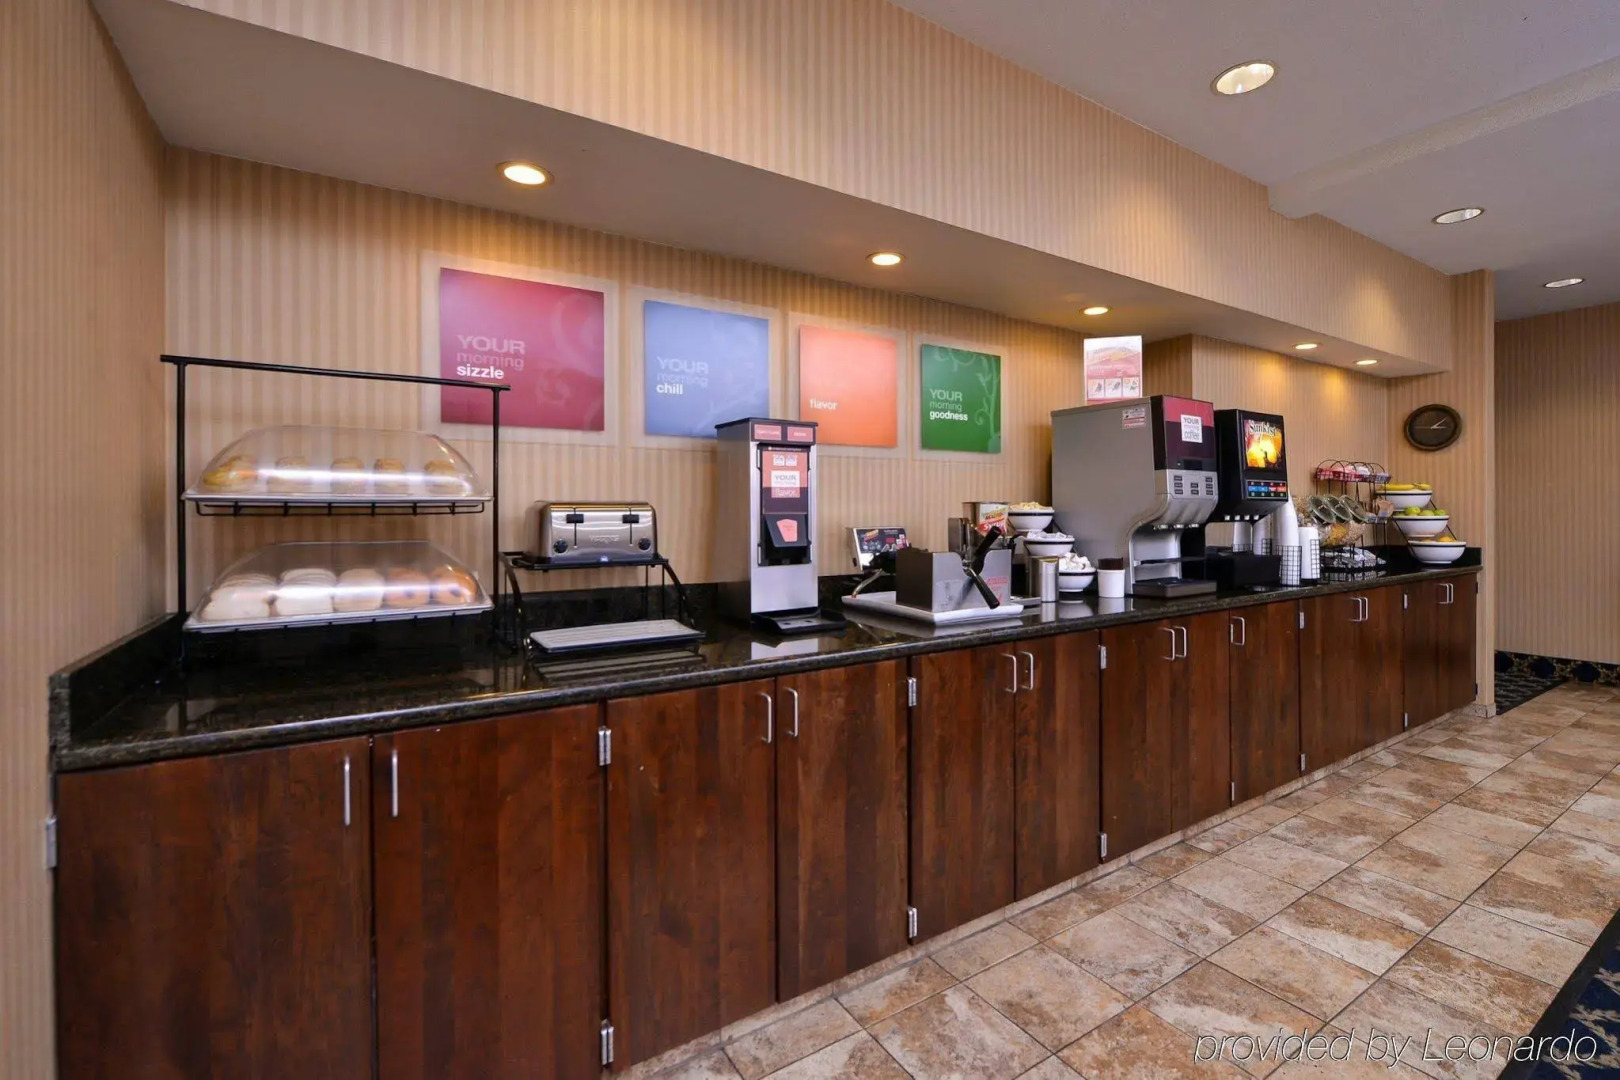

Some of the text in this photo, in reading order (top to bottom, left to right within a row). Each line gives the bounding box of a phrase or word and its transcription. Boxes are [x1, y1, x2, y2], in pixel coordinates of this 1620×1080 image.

[457, 334, 525, 355] YOUR
[457, 352, 524, 372] morning
[656, 355, 709, 374] YOUR
[456, 363, 504, 380] sizzle
[656, 382, 684, 395] chill
[929, 388, 963, 402] YOUR
[810, 397, 838, 411] flavor
[929, 401, 963, 412] morning
[929, 410, 968, 422] goodness
[1183, 417, 1200, 425] YOUR
[1248, 420, 1277, 437] Sunkist
